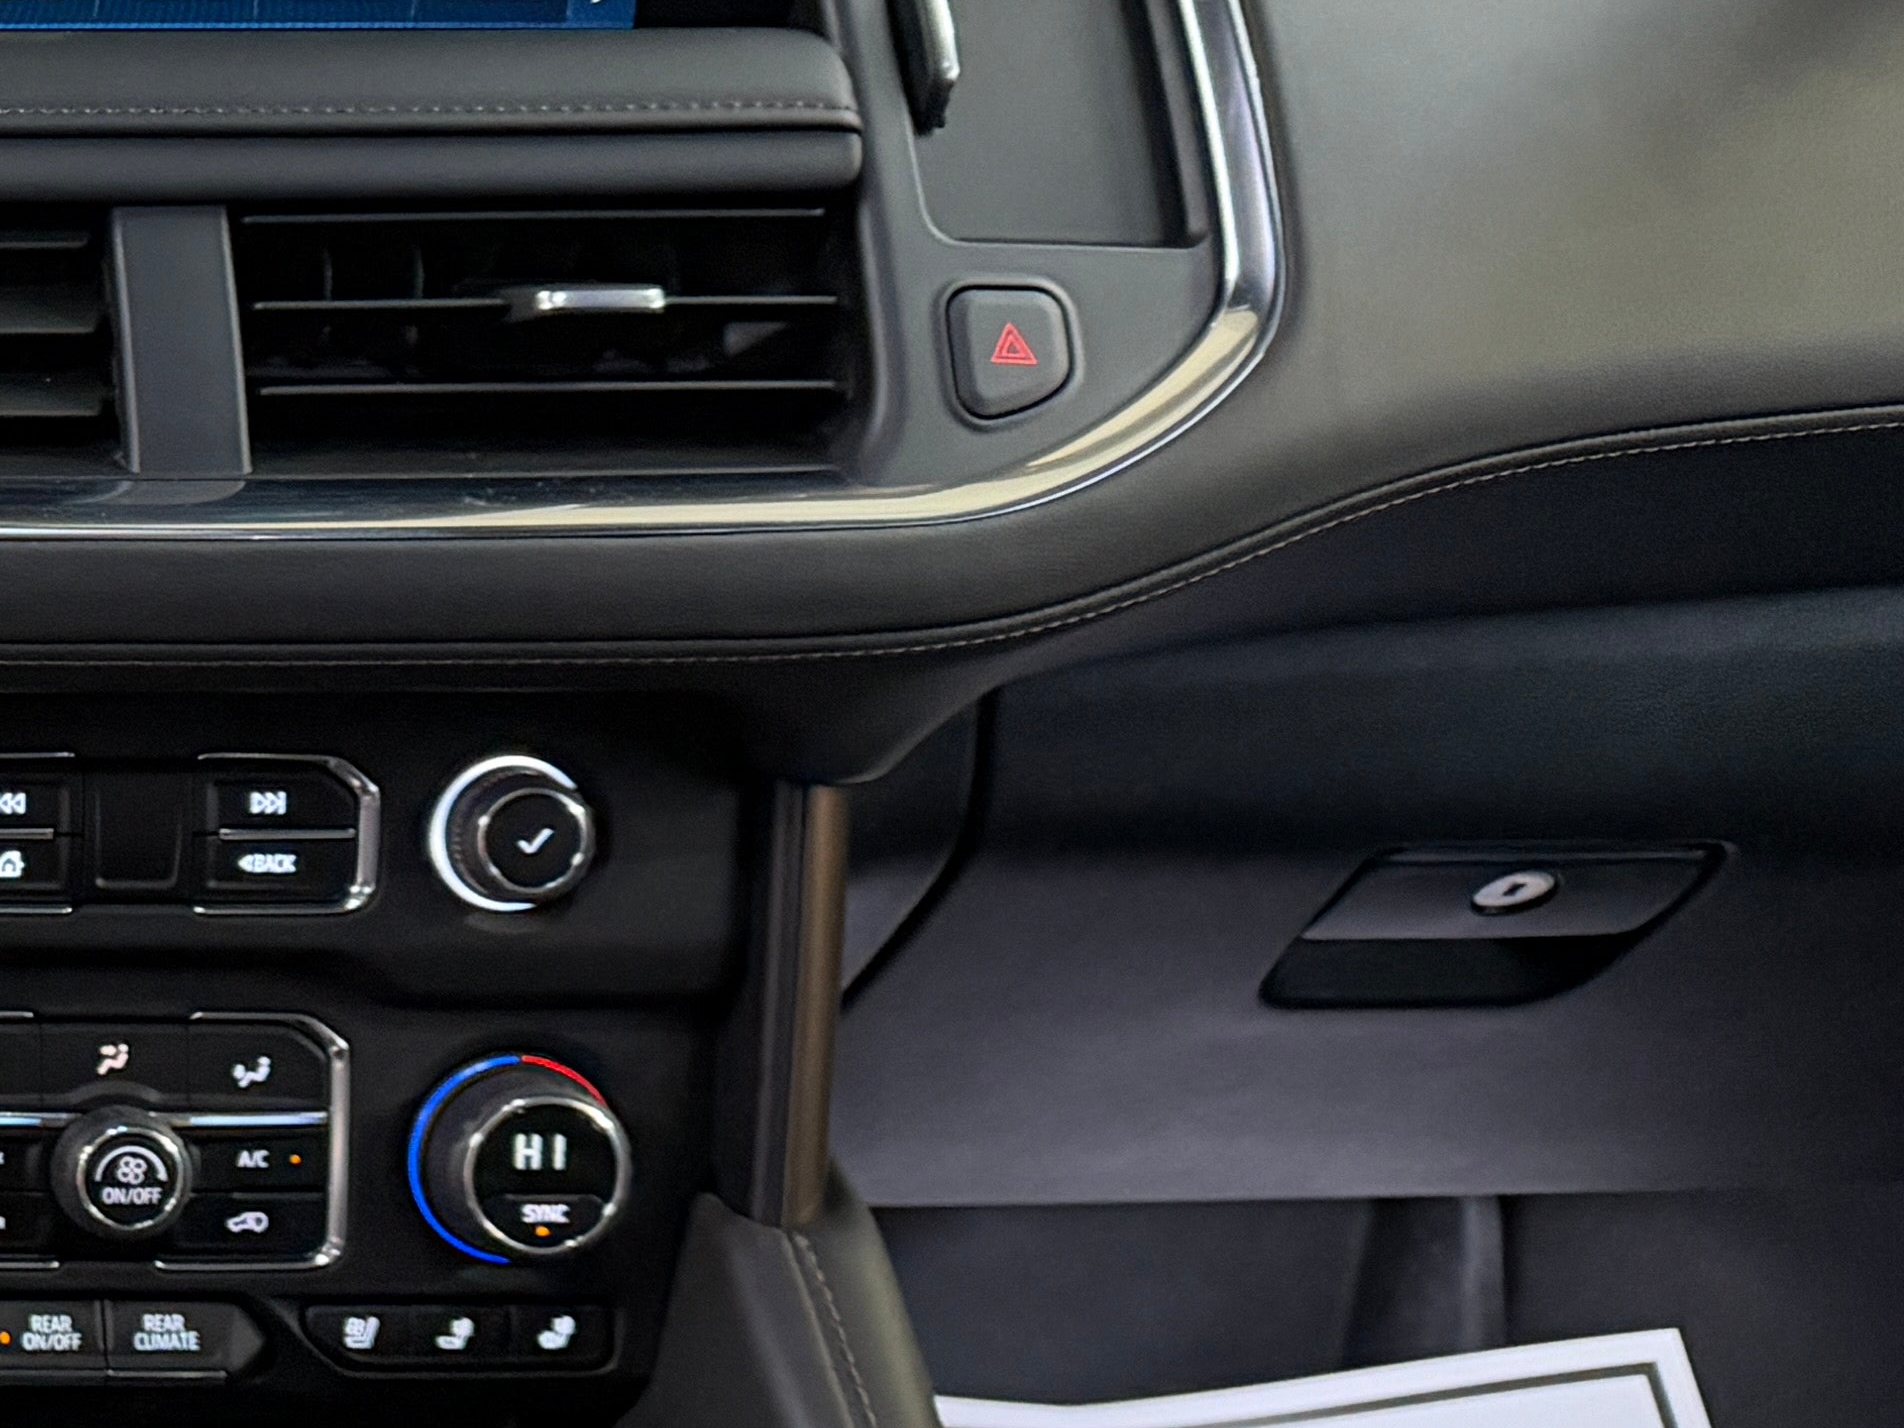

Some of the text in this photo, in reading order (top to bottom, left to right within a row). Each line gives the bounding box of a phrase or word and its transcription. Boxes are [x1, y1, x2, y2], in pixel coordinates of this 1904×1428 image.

[253, 855, 297, 873] BACK
[236, 1150, 270, 1169] A/C
[102, 1186, 162, 1206] ON/OFF
[521, 1203, 570, 1225] SYNC
[30, 1314, 73, 1333] REAR
[142, 1314, 186, 1333] REAR
[22, 1331, 83, 1352] ON/OFF
[133, 1331, 201, 1353] CLIMATE
